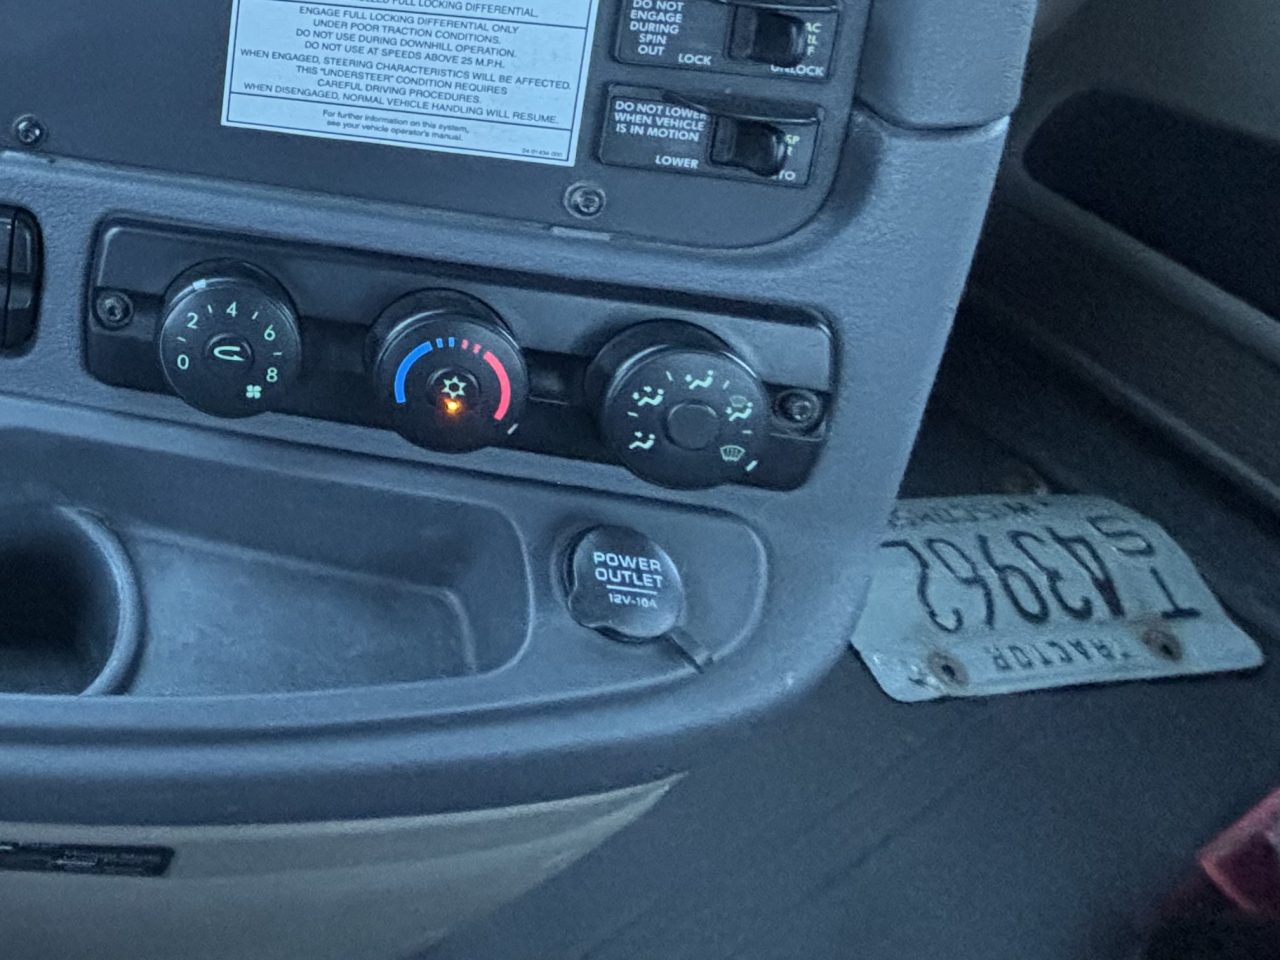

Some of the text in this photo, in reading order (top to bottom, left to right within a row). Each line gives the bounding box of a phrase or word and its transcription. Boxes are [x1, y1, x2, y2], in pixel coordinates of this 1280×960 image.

[655, 0, 684, 12] NOT
[299, 6, 520, 34] ENGAGE FULL LOCKING DIFFERENTIAL ONLY
[630, 10, 683, 23] ENGAGE
[313, 18, 501, 44] UNDER POOR TRACTION CONDITIONS.
[629, 21, 679, 35] DURING
[296, 28, 517, 58] DO NOT USE DURING DOWNHILL OPERATION.
[639, 33, 667, 45] SPIN
[305, 40, 505, 69] DO NOT USE AT SPEEDS ABOVE 25 M.P.H.
[637, 45, 665, 56] OUT
[678, 53, 712, 66] LOCK
[240, 49, 571, 90] WHEN ENGAGED, STEERING CHARACTERISTICS WILL BE AFFECTED.
[615, 100, 708, 121] DO NOT LOWER
[614, 112, 706, 131] WHEN VEHICLE
[616, 123, 700, 142] IS IN MOTION
[655, 155, 699, 169] LOWER
[226, 301, 237, 317] 4
[186, 312, 198, 329] 2
[264, 324, 276, 341] 6
[177, 354, 189, 370] 0
[266, 367, 278, 382] 8
[593, 551, 662, 572] POWER
[595, 568, 663, 588] OUTLET
[881, 527, 1126, 633] 43962
[608, 593, 658, 609] 12V-10A
[1150, 566, 1202, 619] T
